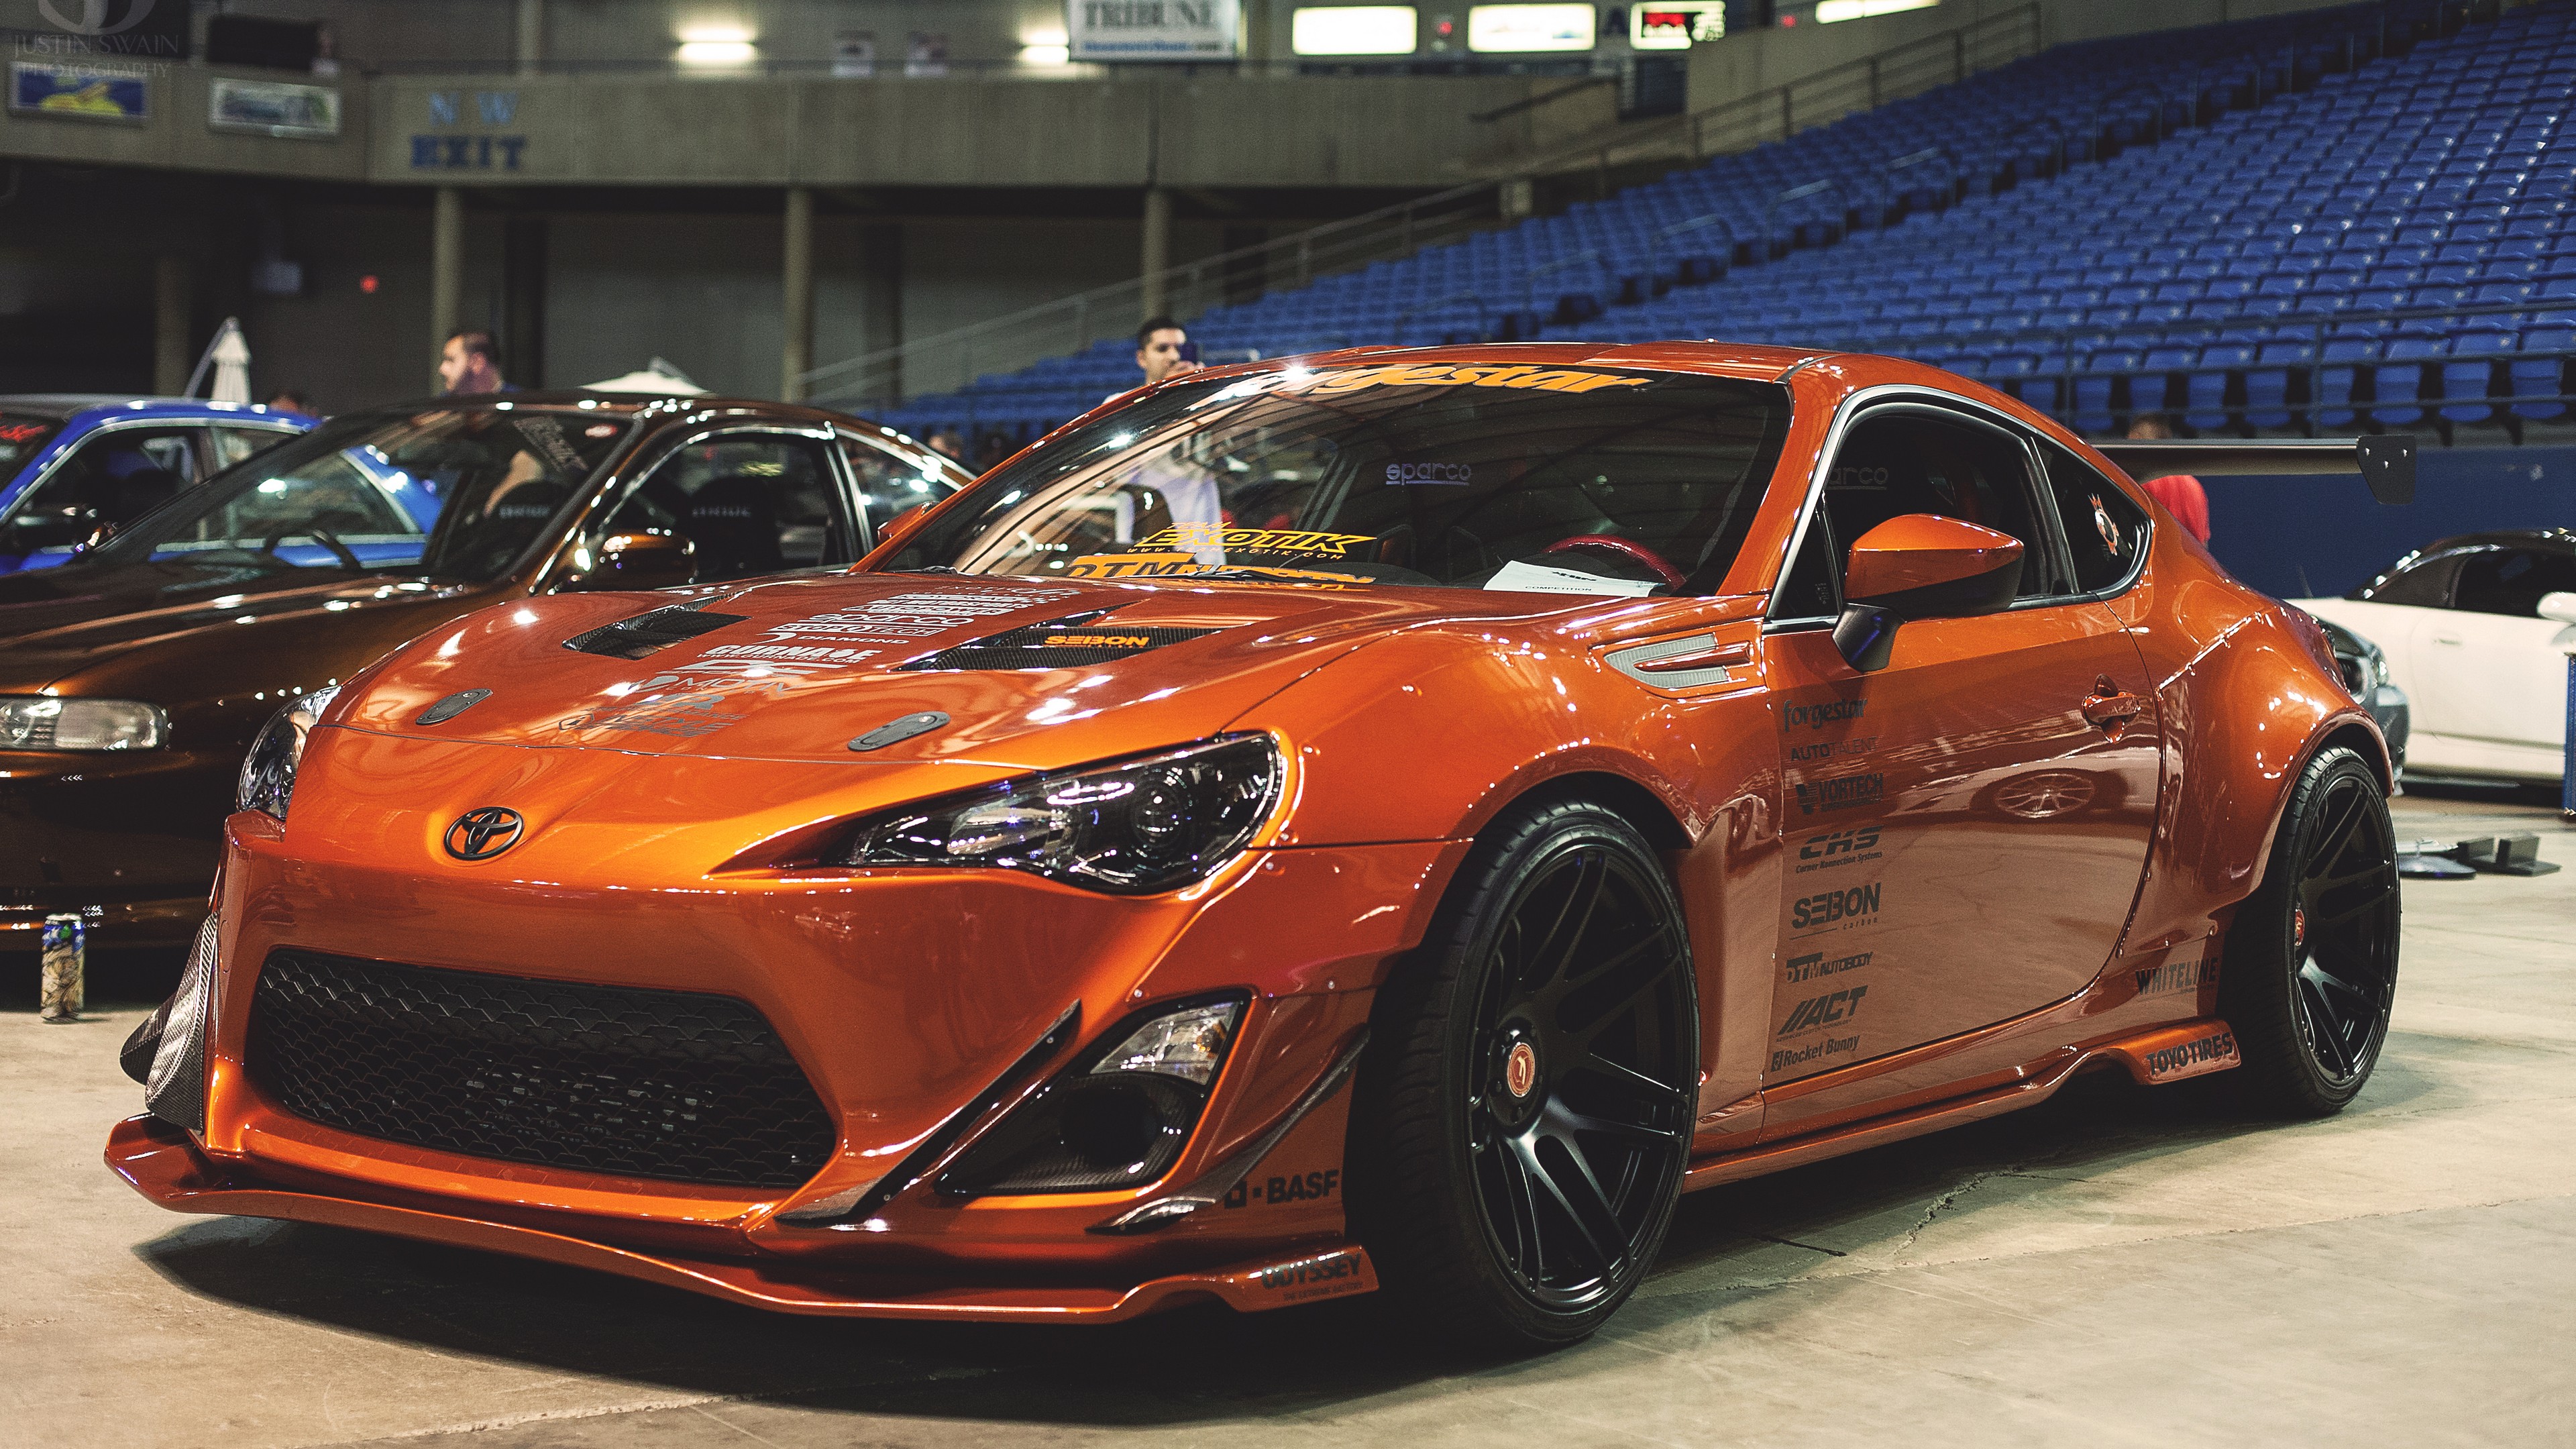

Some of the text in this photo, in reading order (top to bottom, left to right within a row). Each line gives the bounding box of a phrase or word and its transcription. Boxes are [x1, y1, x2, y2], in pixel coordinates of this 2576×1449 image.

[411, 136, 527, 168] EXIT
[1386, 463, 1472, 486] sparco
[1134, 528, 1379, 555] EXOTIK
[808, 613, 975, 625] sparco
[796, 635, 910, 645] DIAMOND
[696, 653, 861, 664] WWW.GURNADE.COM
[1783, 698, 1868, 733] forgestar
[1819, 773, 1884, 803] VORTECH
[1843, 916, 1878, 930] carbon
[2135, 957, 2219, 996] WHITELINE
[1783, 1034, 1861, 1067] Rocket Bunny
[1267, 1169, 1340, 1205] BASF
[1261, 1252, 1362, 1289] ODYSSEY
